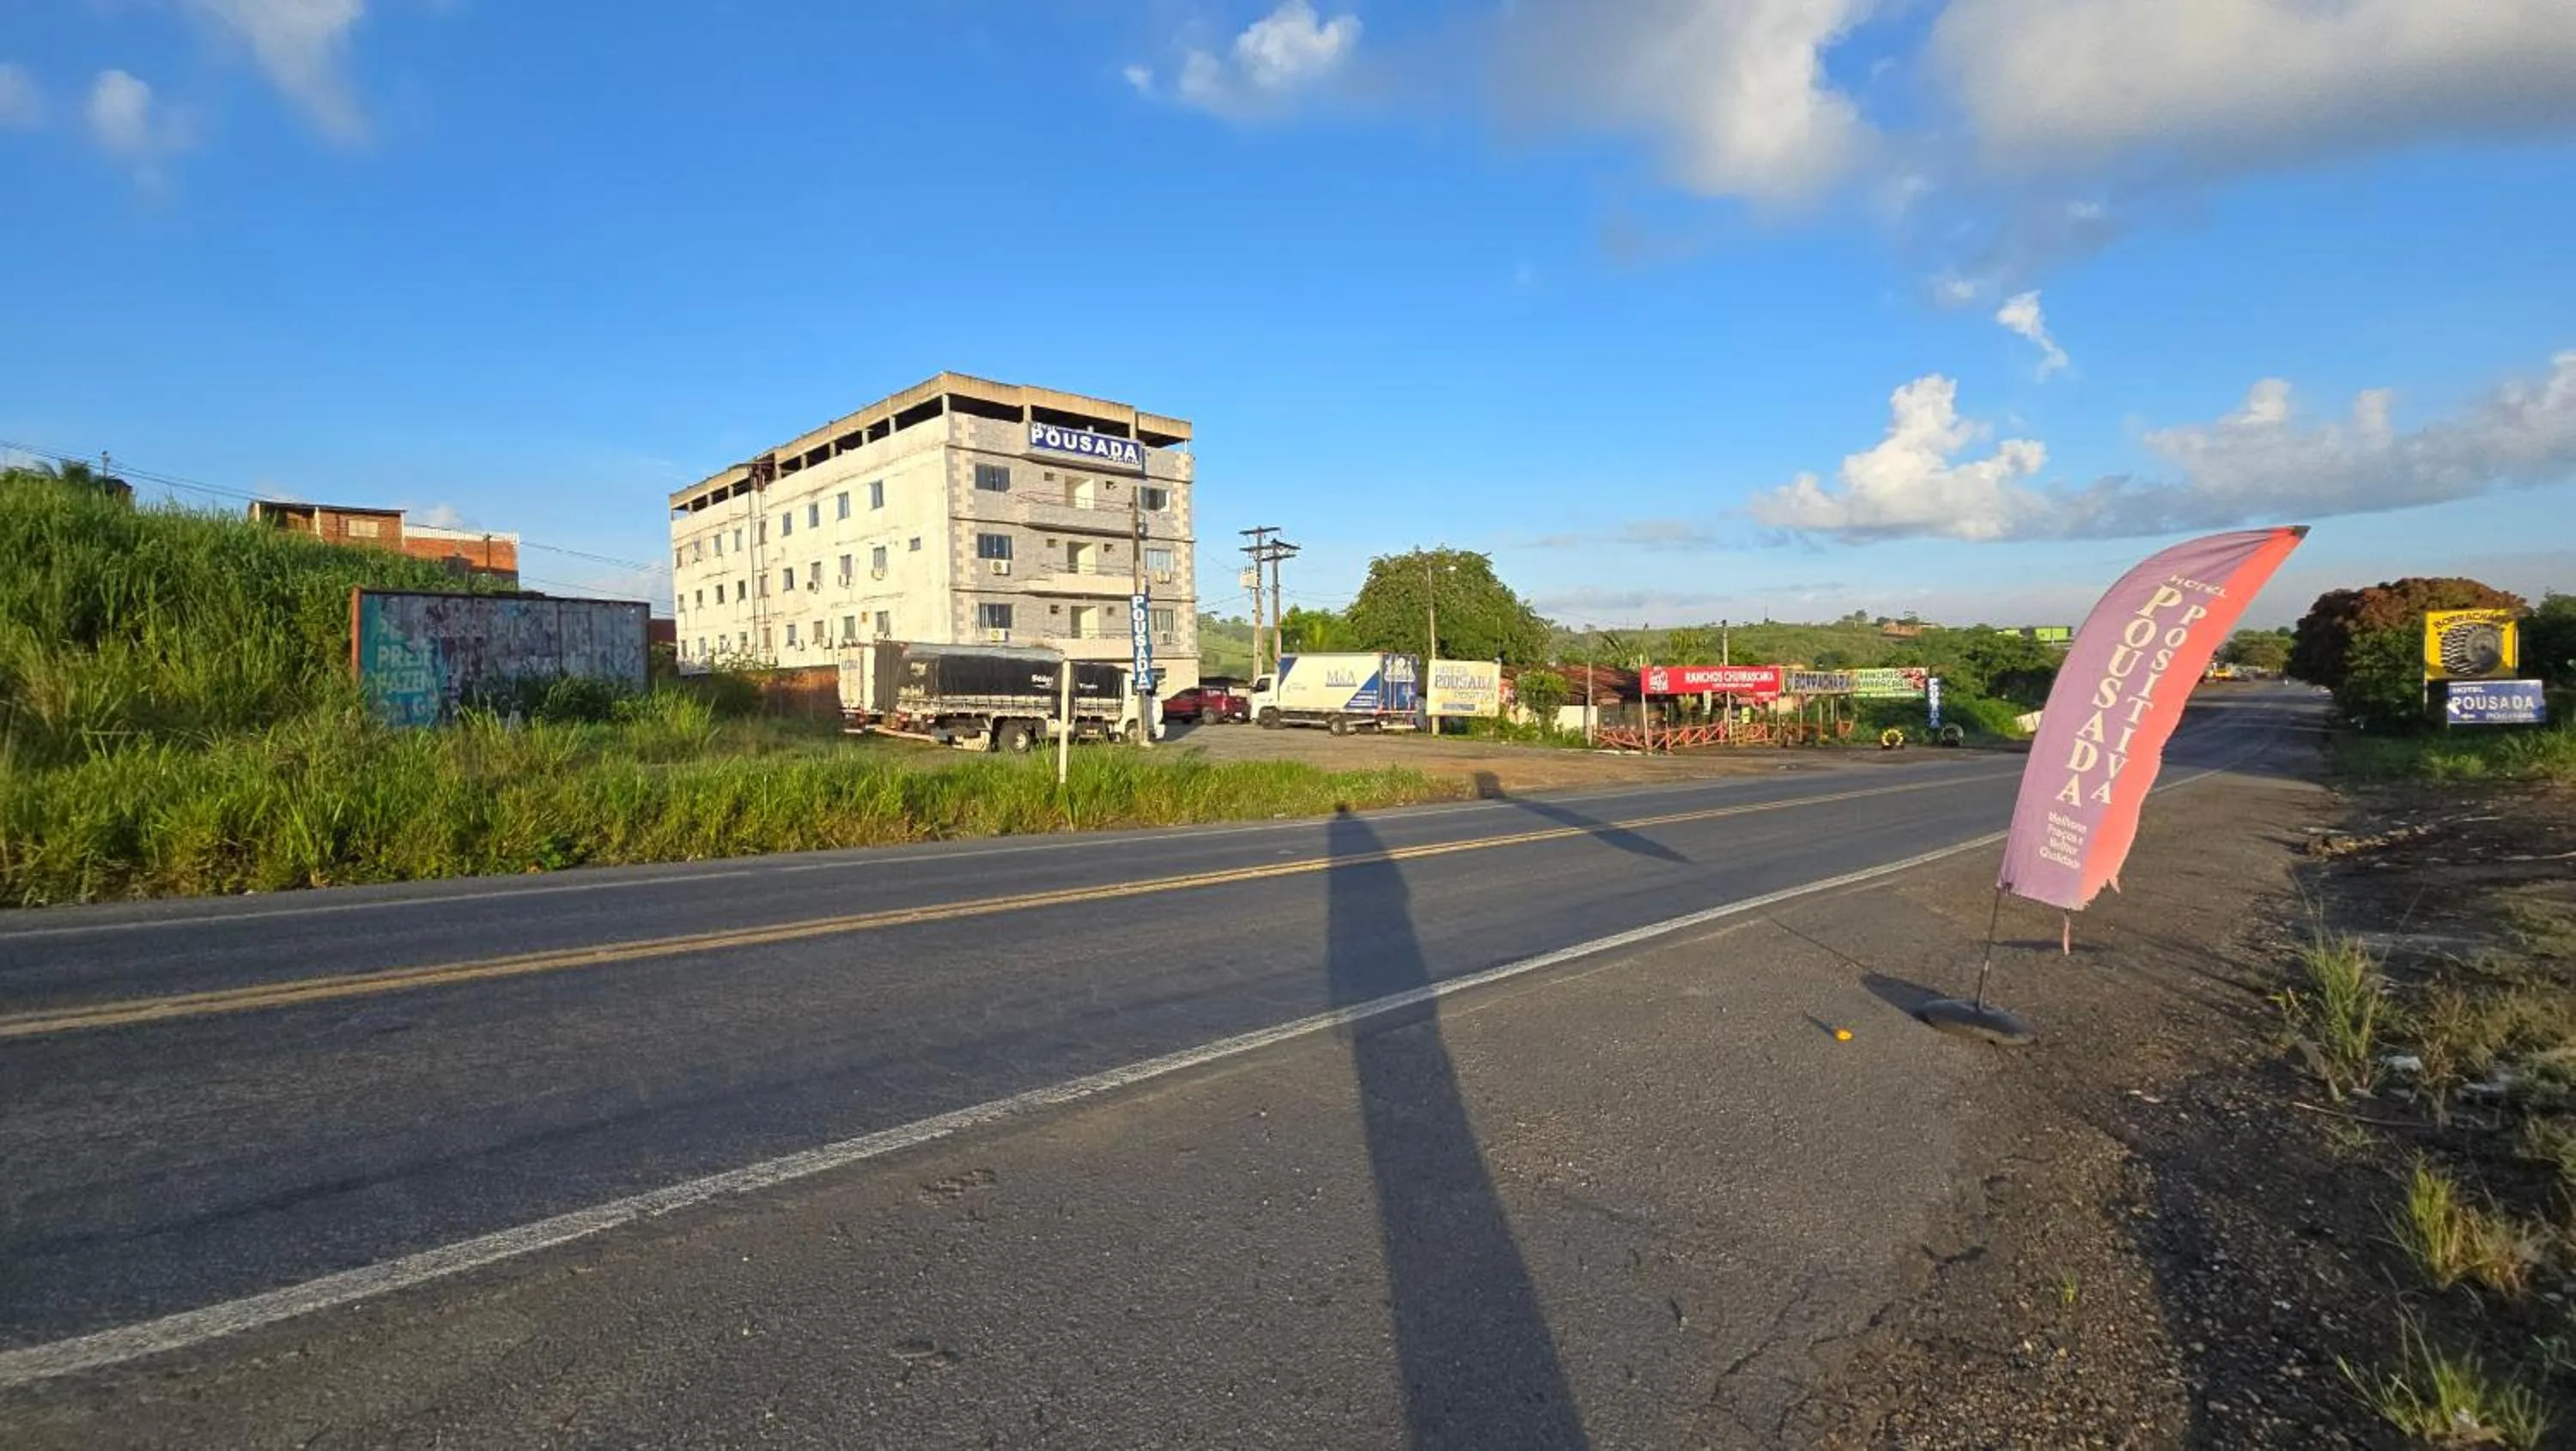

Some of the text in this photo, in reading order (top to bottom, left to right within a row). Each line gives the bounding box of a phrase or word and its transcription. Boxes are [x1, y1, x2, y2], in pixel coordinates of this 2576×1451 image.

[1031, 428, 1137, 464] POUSADA
[1132, 595, 1149, 684] POUSADA
[1436, 675, 1496, 690] POUSADA
[1685, 672, 1722, 683] RANCHOS
[2056, 585, 2182, 807] POUSADA
[2090, 604, 2208, 804] POSITIVA
[2451, 695, 2535, 712] POUSADA
